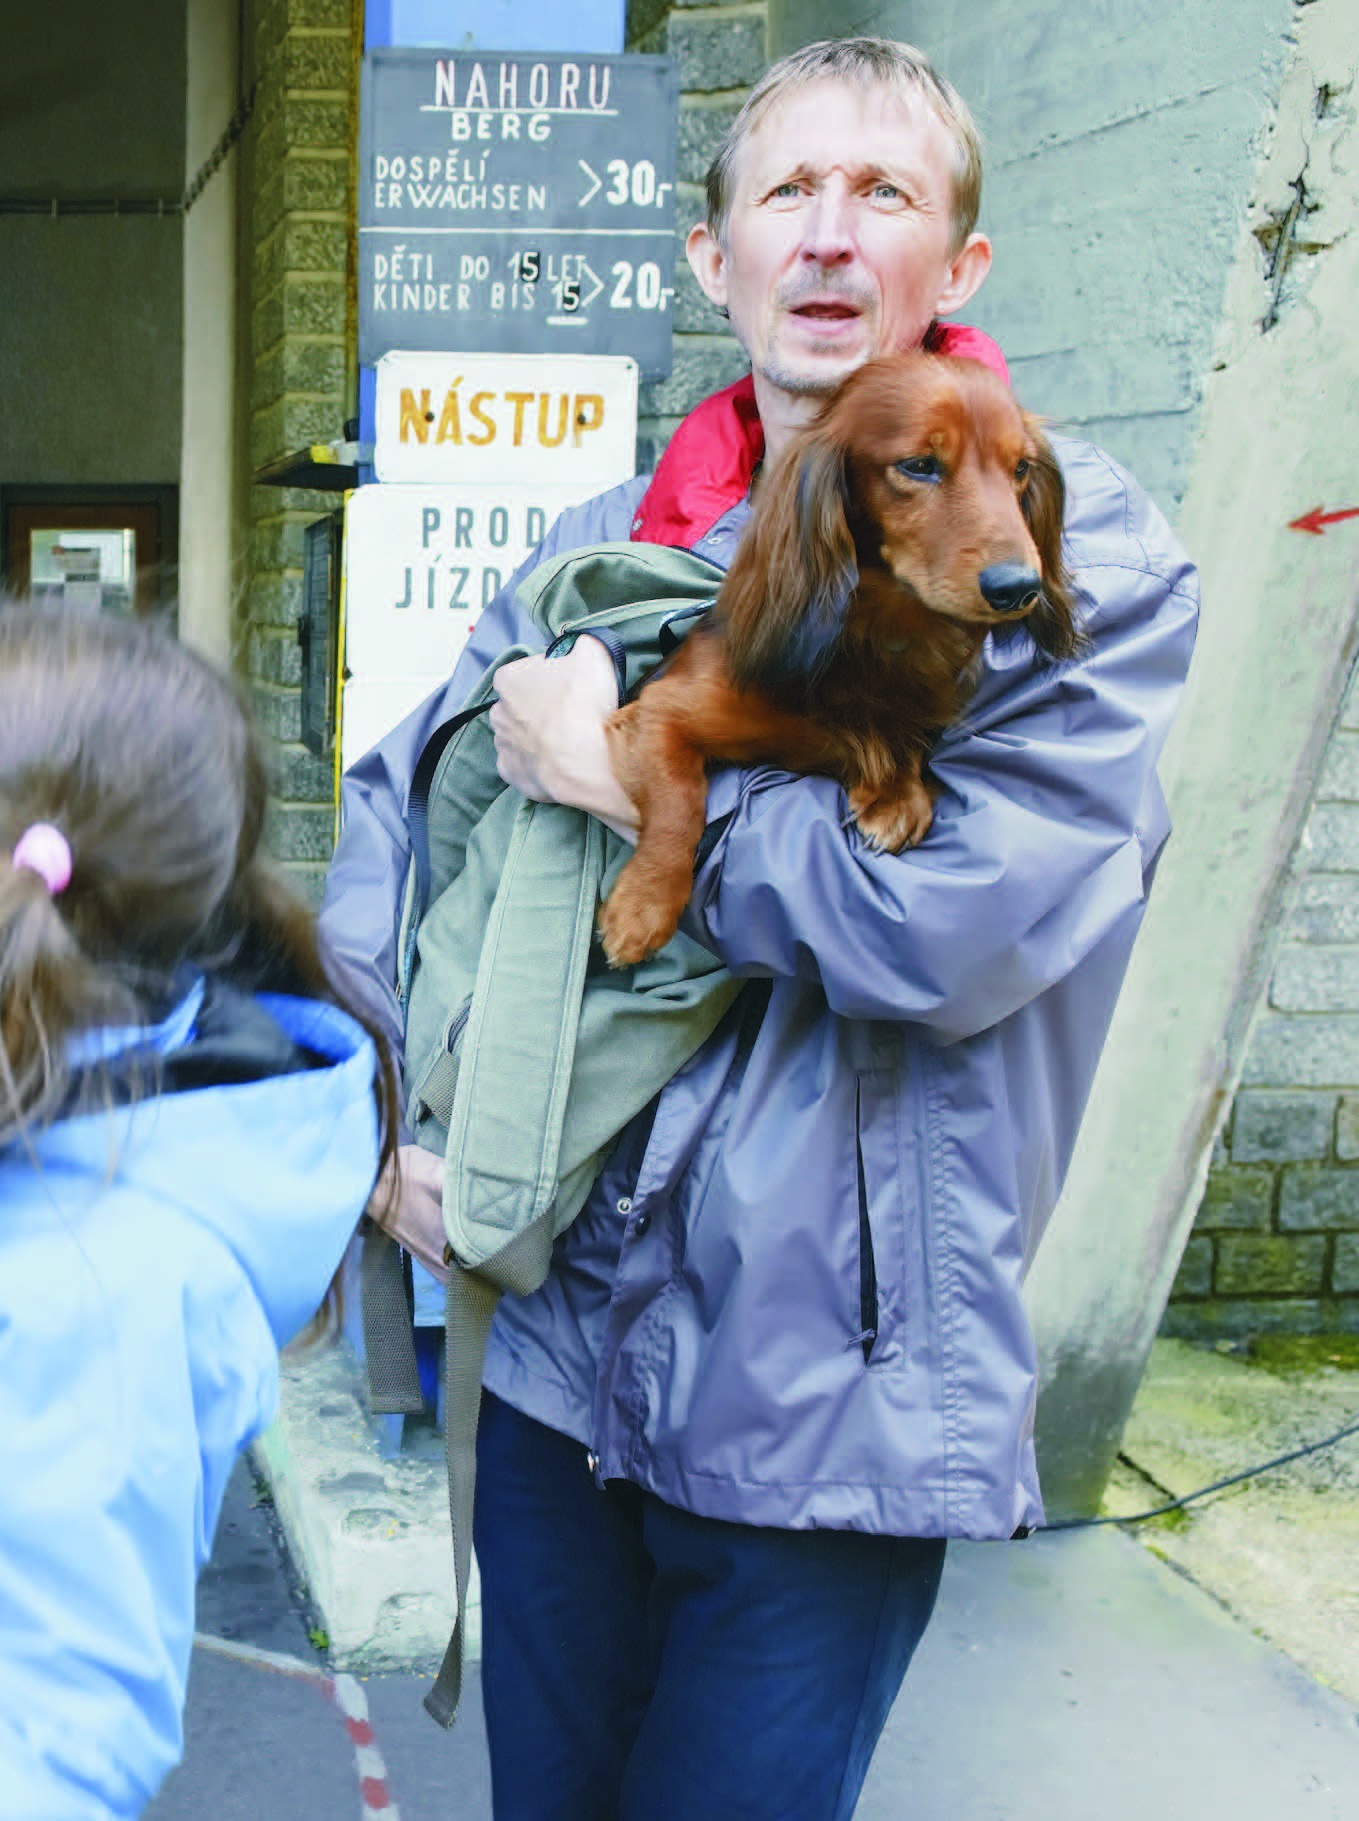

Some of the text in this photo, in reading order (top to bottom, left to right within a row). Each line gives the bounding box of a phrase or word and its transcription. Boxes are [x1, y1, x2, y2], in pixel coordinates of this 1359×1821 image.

[435, 60, 611, 110] NAHORU
[451, 113, 552, 141] BERG
[375, 149, 491, 182] DOSPĚLÍ
[374, 184, 547, 211] ERWACHSEN
[374, 245, 586, 282] DĚTI DO 15 LET
[373, 280, 580, 311] KINDER BIS 15
[398, 375, 606, 449] NÁSTUP
[421, 507, 576, 549] PROD
[394, 553, 520, 609] JÍZD
